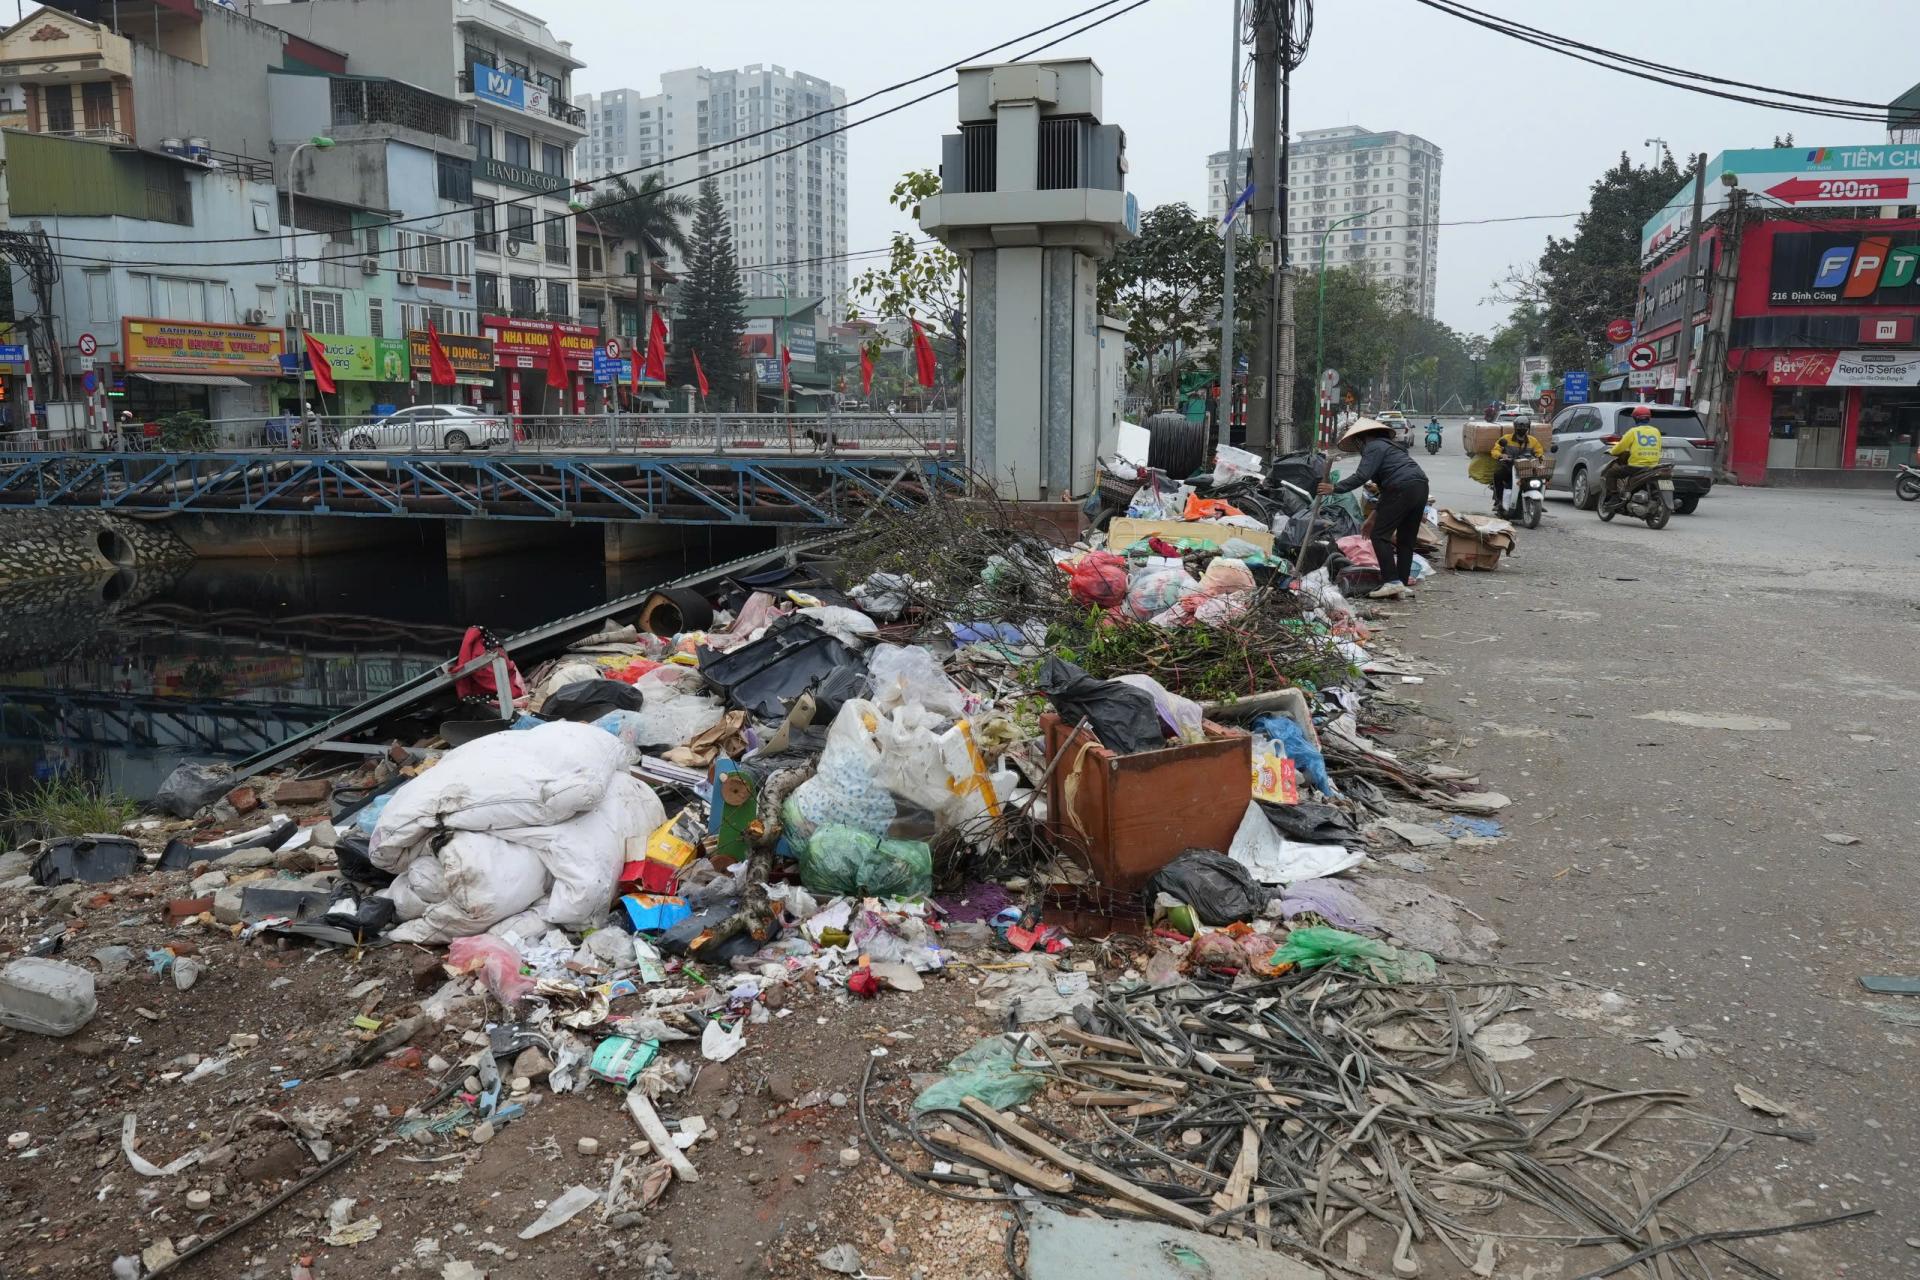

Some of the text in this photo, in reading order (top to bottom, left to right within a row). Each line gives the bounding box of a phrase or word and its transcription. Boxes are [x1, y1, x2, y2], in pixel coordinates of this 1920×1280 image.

[1841, 147, 1920, 168] TIÊM CH
[486, 161, 557, 191] HAND DECOR
[1818, 180, 1879, 198] 200m
[1820, 255, 1915, 278] FPT
[1772, 291, 1837, 302] 216 Định Công
[503, 330, 523, 344] NHA
[524, 332, 549, 346] KHOA
[579, 338, 594, 350] GIA
[452, 346, 478, 360] DỤNG
[1773, 360, 1796, 376] Bật
[1876, 365, 1907, 374] Series
[1636, 431, 1657, 447] be
